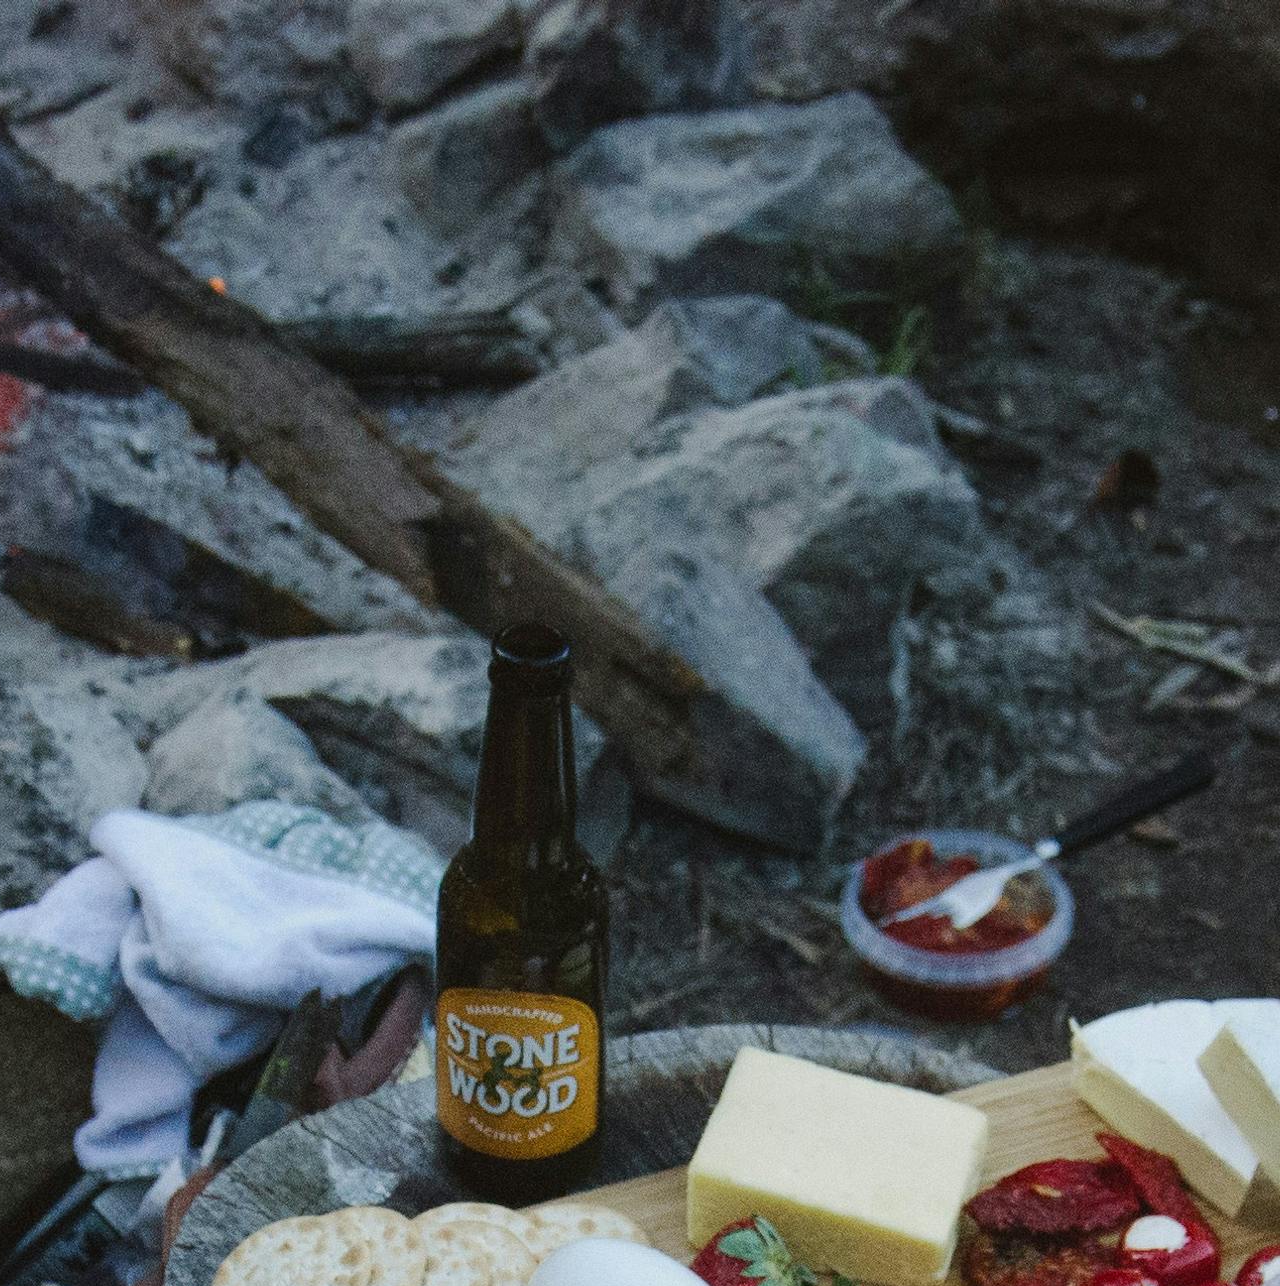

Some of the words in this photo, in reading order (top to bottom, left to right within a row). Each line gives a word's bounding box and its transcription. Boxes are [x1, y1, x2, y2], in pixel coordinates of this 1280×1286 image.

[465, 1004, 564, 1024] HANDCRAFTED
[446, 1011, 580, 1069] STONE
[447, 1054, 578, 1118] WOOD
[467, 1115, 523, 1143] PACIFIC
[526, 1121, 554, 1141] ALE
